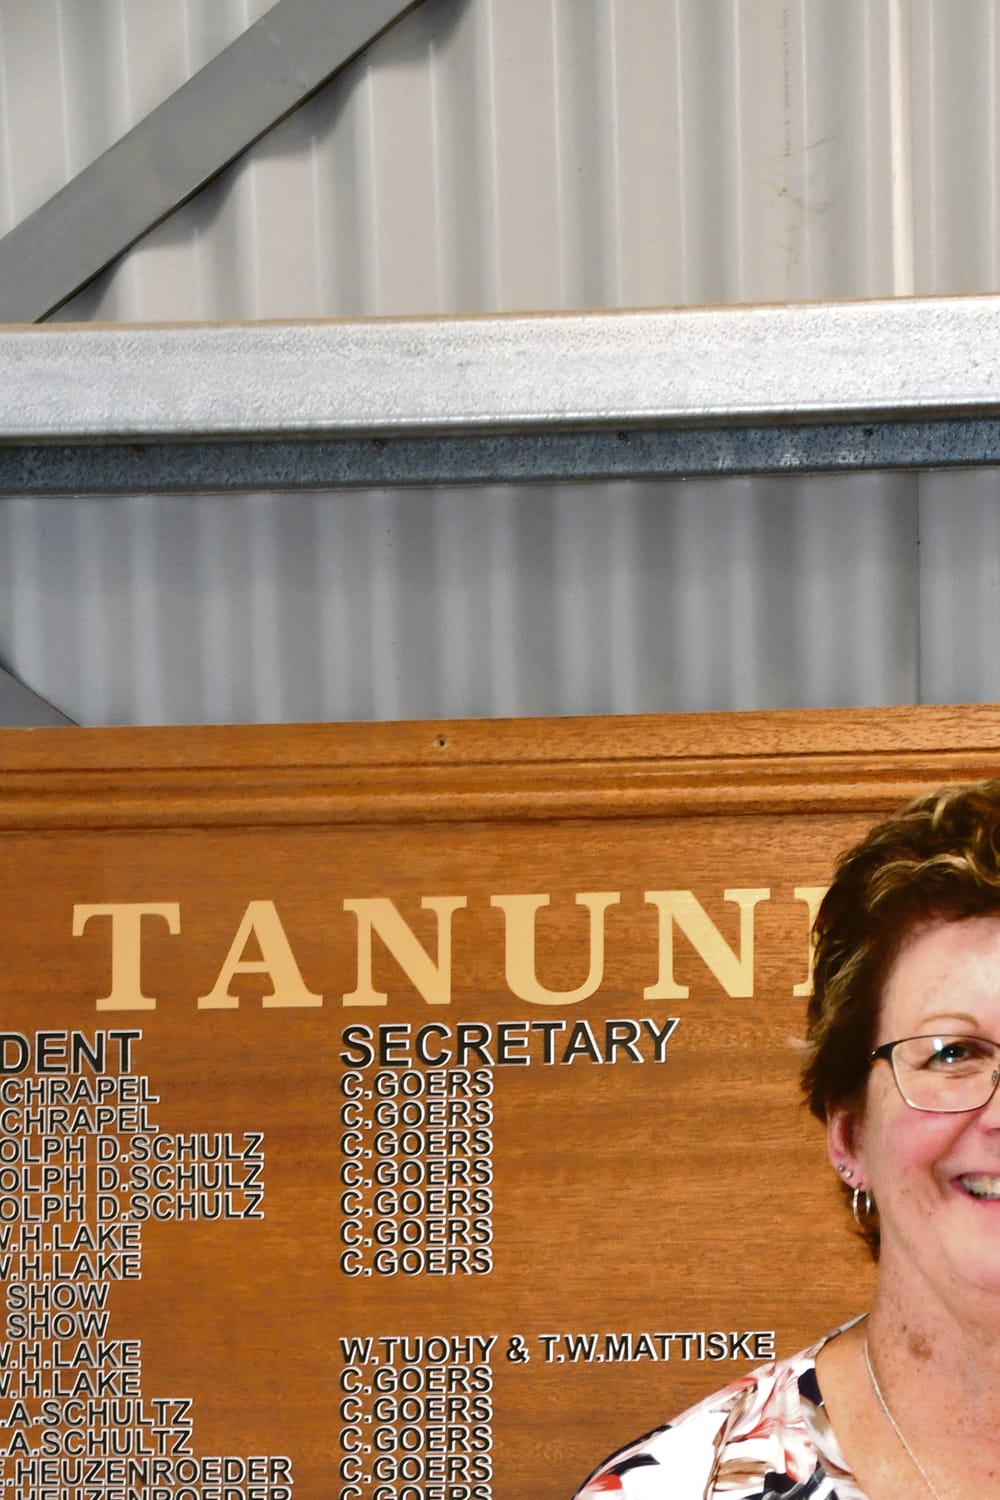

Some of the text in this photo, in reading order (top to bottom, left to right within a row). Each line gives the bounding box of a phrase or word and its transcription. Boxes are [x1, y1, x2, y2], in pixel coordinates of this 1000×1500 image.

[340, 1017, 680, 1069] SECRETARY
[340, 1069, 494, 1100] C.GOERS
[340, 1099, 494, 1129] C.GOERS
[96, 1132, 265, 1163] D.SCHULZ
[340, 1129, 494, 1159] C.GOERS
[96, 1162, 265, 1192] D.SCHULZ
[340, 1158, 494, 1188] C.GOERS
[96, 1191, 265, 1221] D.SCHULZ
[340, 1188, 494, 1218] C.GOERS
[340, 1218, 494, 1248] C.GOERS
[340, 1248, 494, 1277] C.GOERS
[7, 1281, 110, 1311] SHOW
[7, 1311, 110, 1340] SHOW
[340, 1331, 776, 1365] W.TUOHY & T.W.MATTISKE
[338, 1366, 494, 1396] C.GOERS
[338, 1396, 494, 1426] C.GOERS
[338, 1425, 494, 1455] C.GOERS
[338, 1455, 494, 1485] C.GOERS
